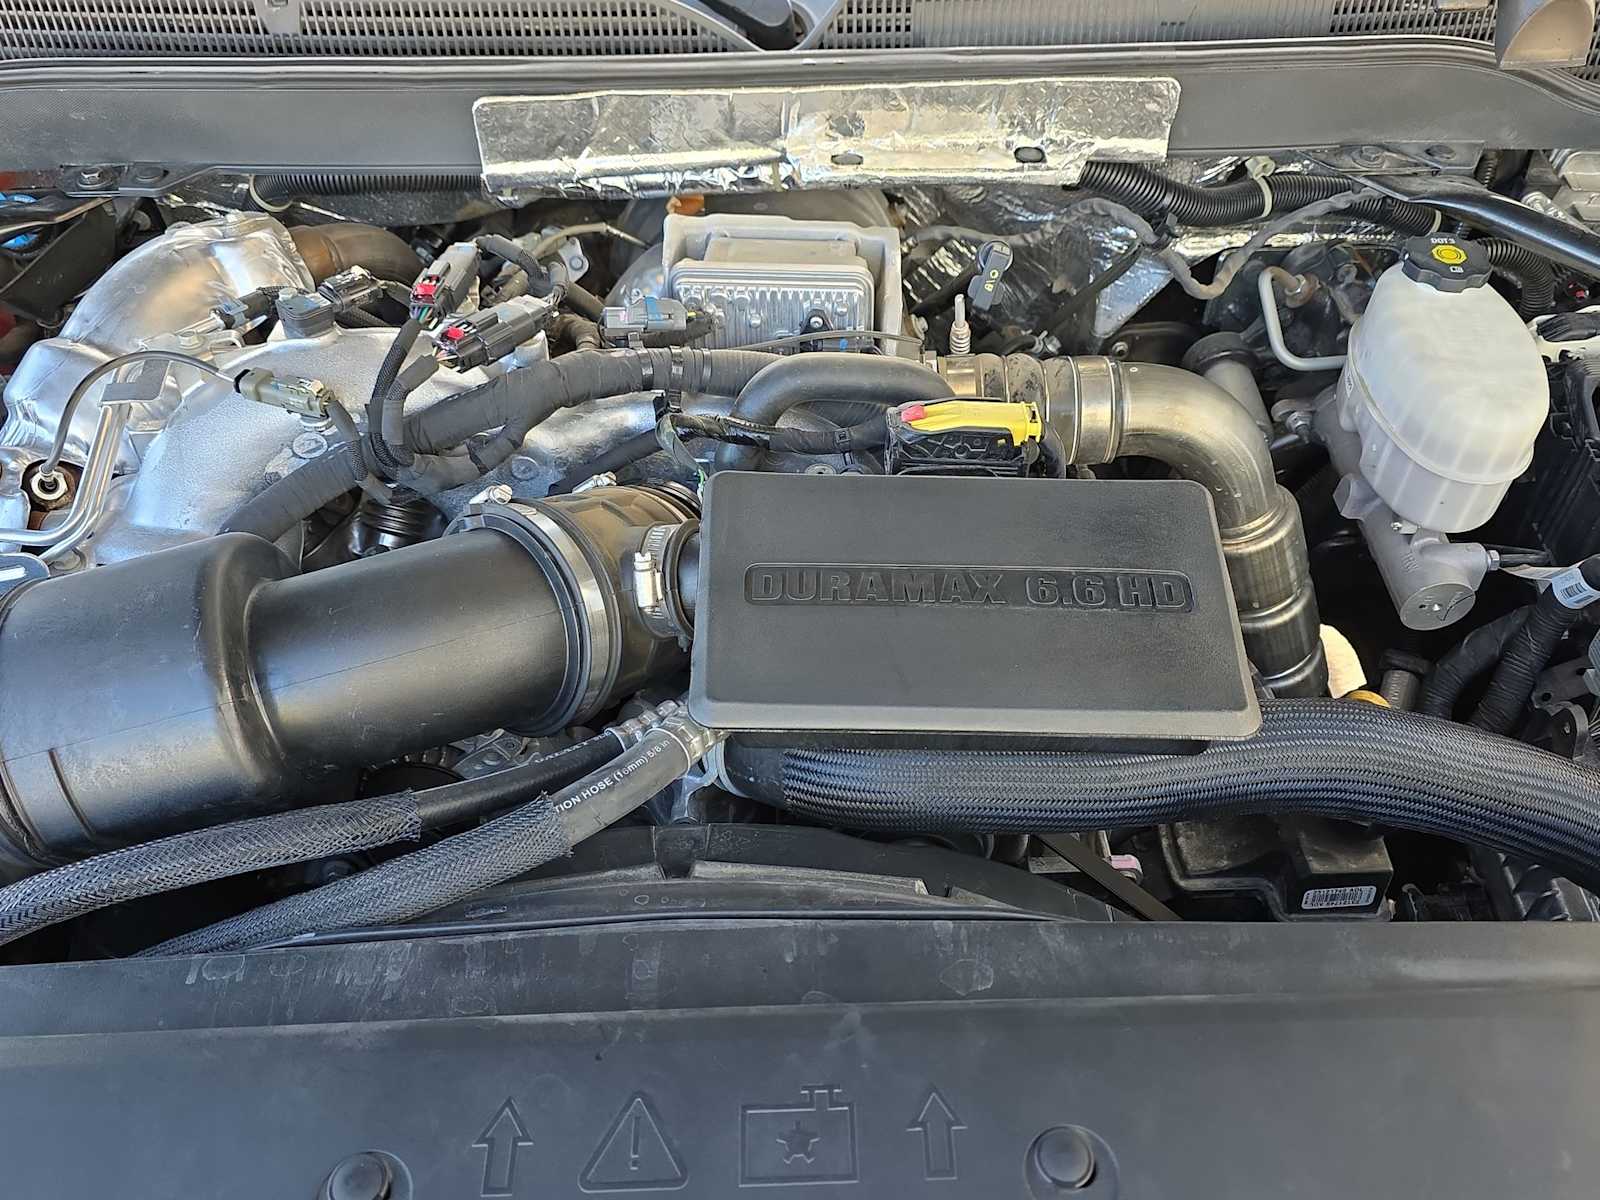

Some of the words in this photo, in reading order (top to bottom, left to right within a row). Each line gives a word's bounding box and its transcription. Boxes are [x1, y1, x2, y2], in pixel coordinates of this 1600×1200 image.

[751, 570, 1006, 604] DURAMAX
[1025, 574, 1107, 607] 6.6
[1116, 575, 1188, 609] HD
[581, 777, 614, 801] HOSE
[613, 755, 649, 782] (16mm)
